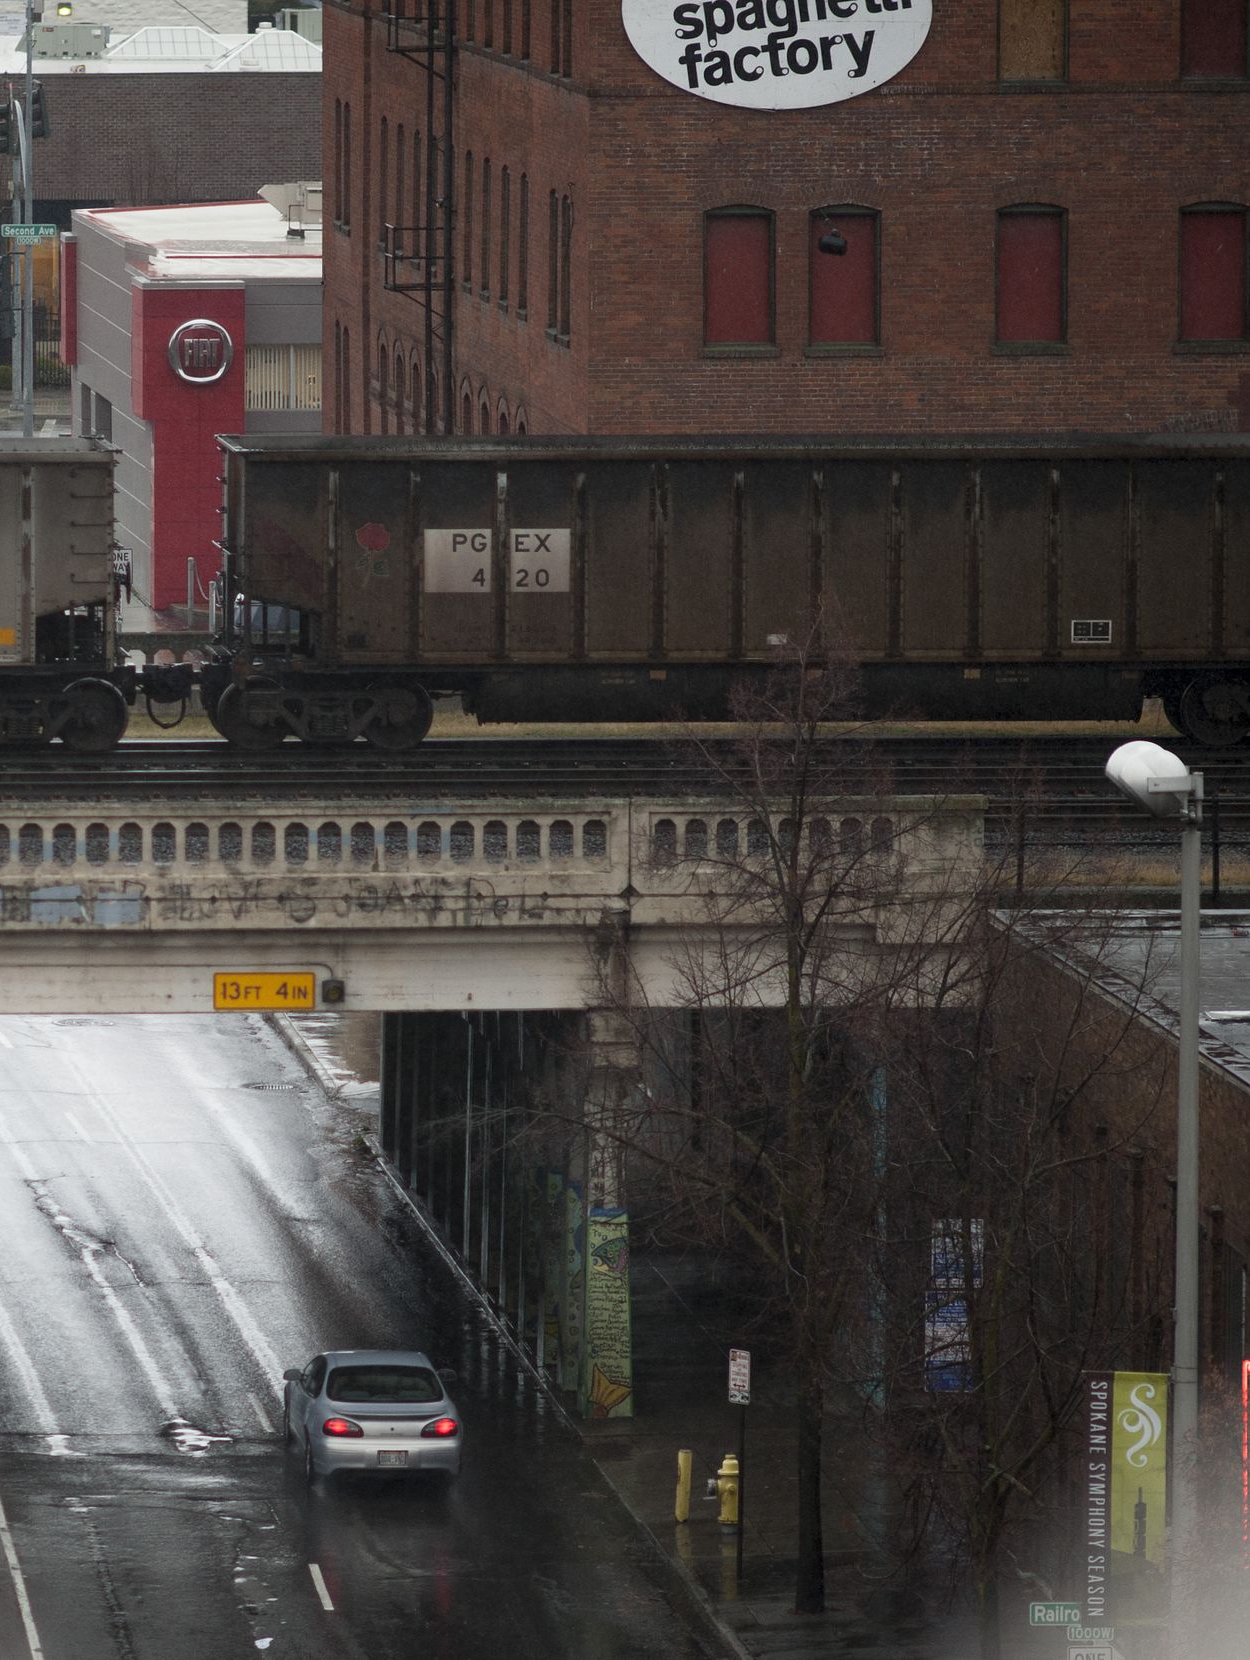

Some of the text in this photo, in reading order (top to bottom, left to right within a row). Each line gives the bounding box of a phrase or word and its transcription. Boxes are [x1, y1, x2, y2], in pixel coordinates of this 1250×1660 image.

[672, 0, 913, 47] spaghe
[678, 30, 875, 89] factory
[4, 226, 54, 236] Second Ave
[184, 338, 221, 368] FIAT
[452, 533, 552, 552] PG EX
[471, 568, 550, 587] 4 20
[1087, 1381, 1109, 1617] SPOKANE SYMPHONY SEASON
[1034, 1605, 1080, 1622] Railro
[1070, 1627, 1110, 1639] 1000W
